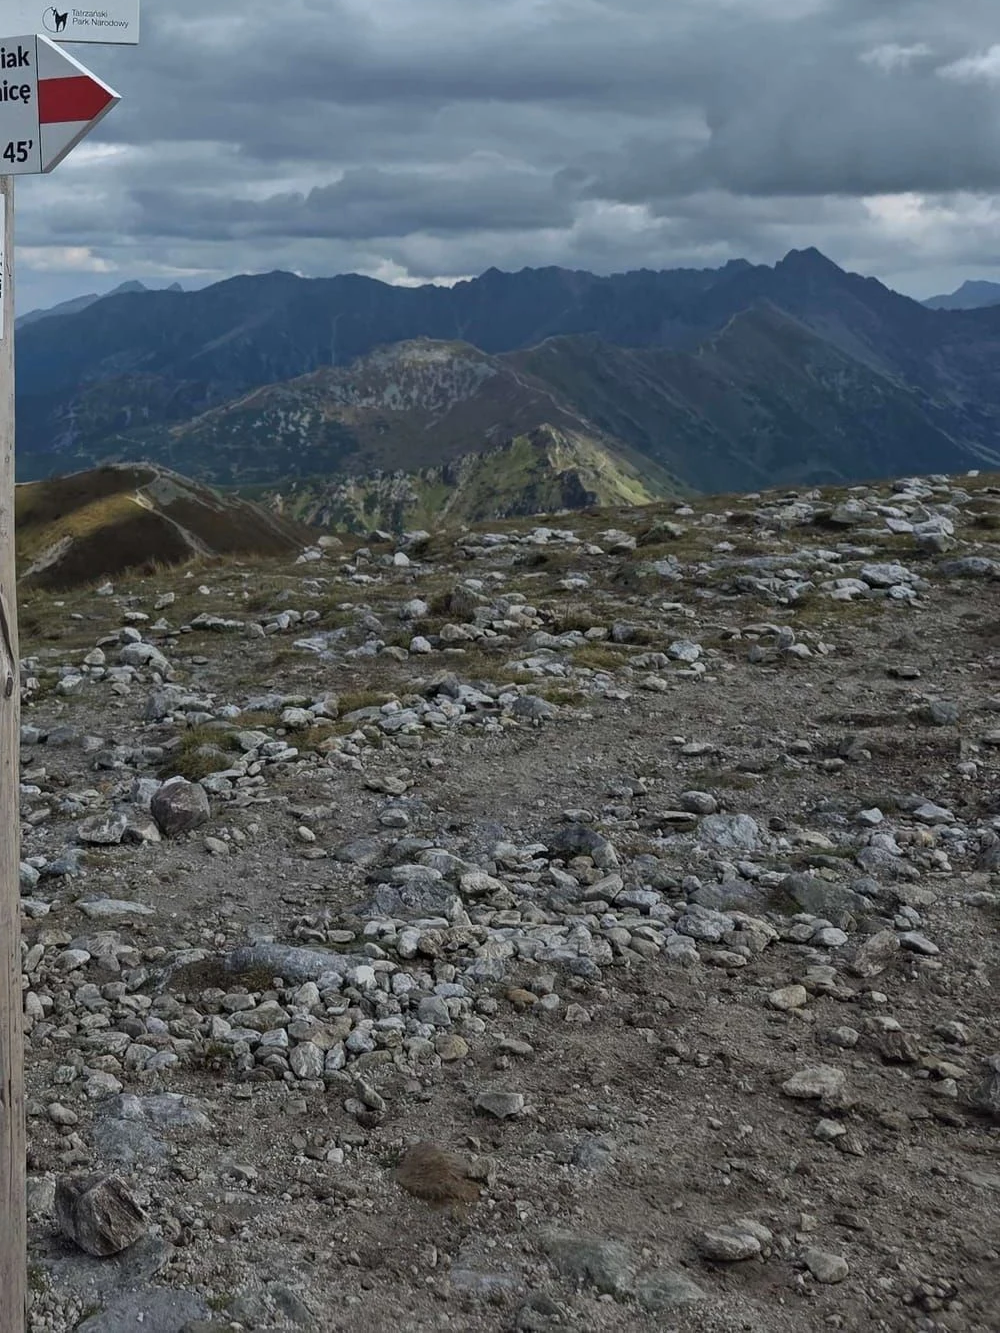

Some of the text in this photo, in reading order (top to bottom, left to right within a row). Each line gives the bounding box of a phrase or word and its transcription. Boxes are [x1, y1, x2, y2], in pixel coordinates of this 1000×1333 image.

[72, 9, 108, 18] Tatrzański
[72, 18, 128, 29] Park Narodowy
